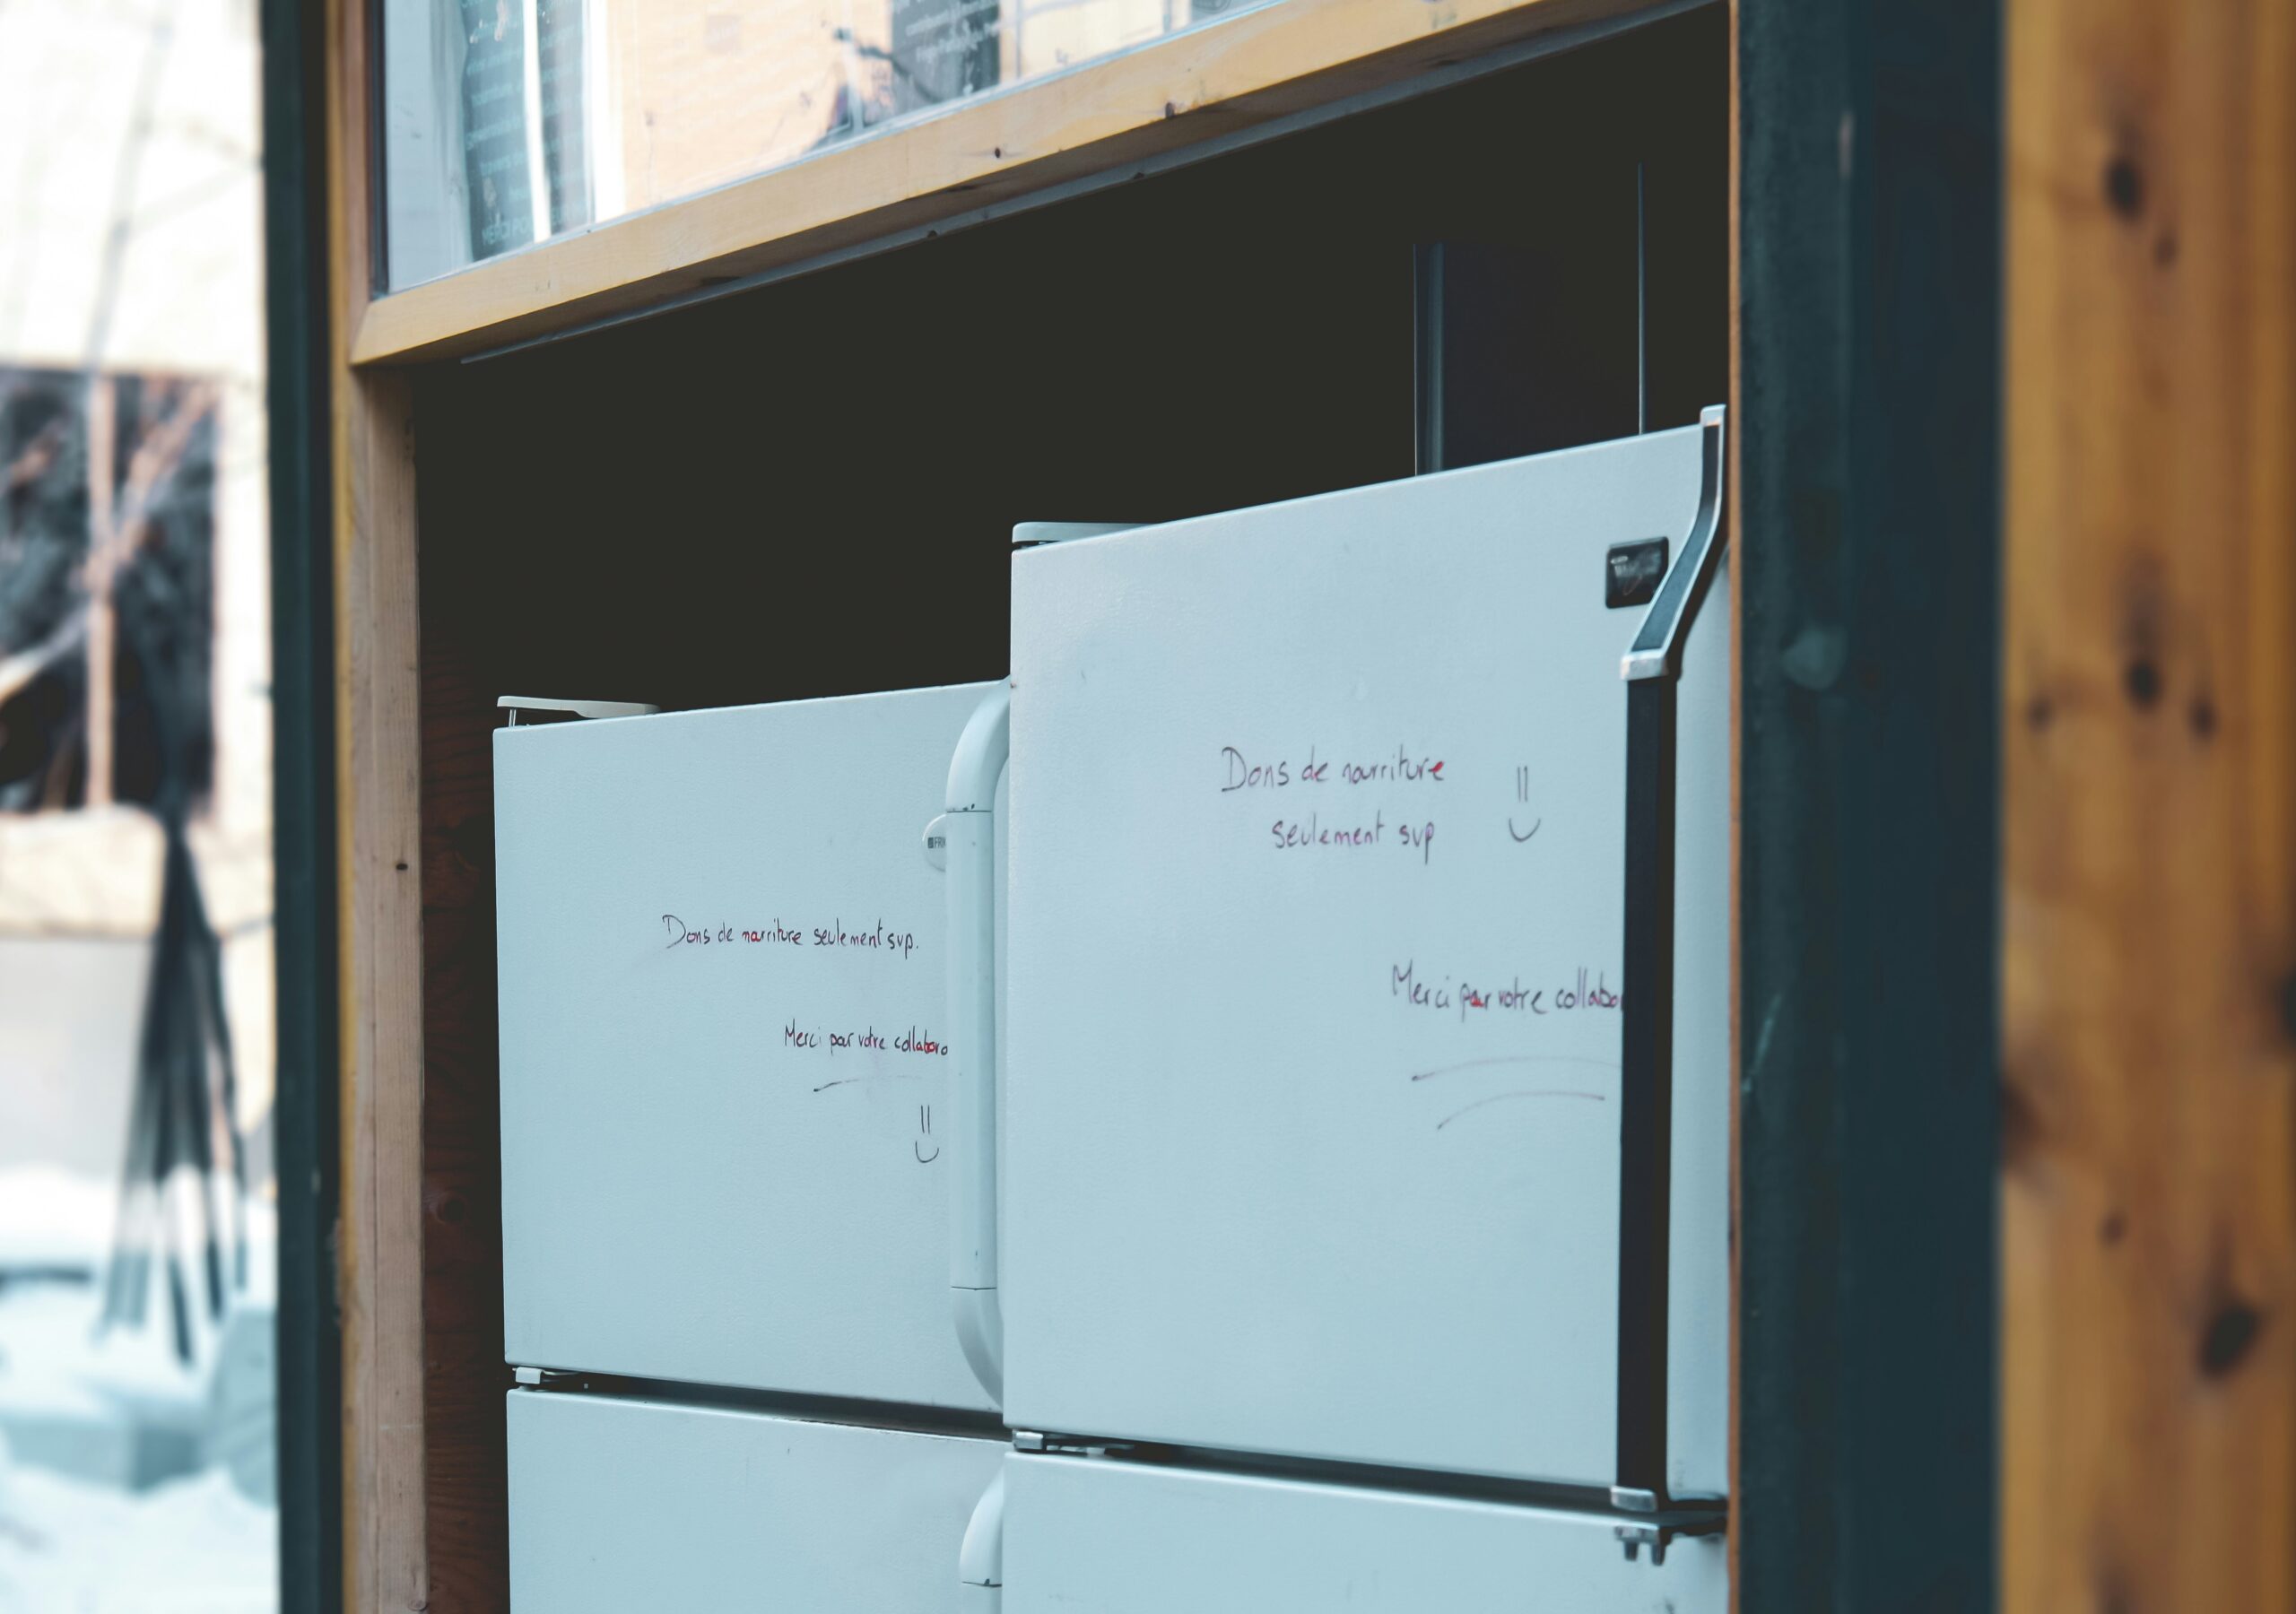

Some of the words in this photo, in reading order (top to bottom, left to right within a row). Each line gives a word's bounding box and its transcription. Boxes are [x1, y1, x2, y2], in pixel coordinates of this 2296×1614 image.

[1221, 746, 1290, 793] Dons
[1301, 746, 1328, 783] de
[1272, 810, 1385, 849] seulement
[1398, 821, 1435, 865] svp
[662, 915, 710, 949] Dons
[718, 921, 735, 942] de
[813, 917, 883, 949] seulement
[887, 933, 918, 960] svp.
[1392, 959, 1449, 1009] Merci
[1498, 976, 1550, 1015] votre
[785, 1018, 822, 1048] Merci
[858, 1026, 888, 1050] votre
